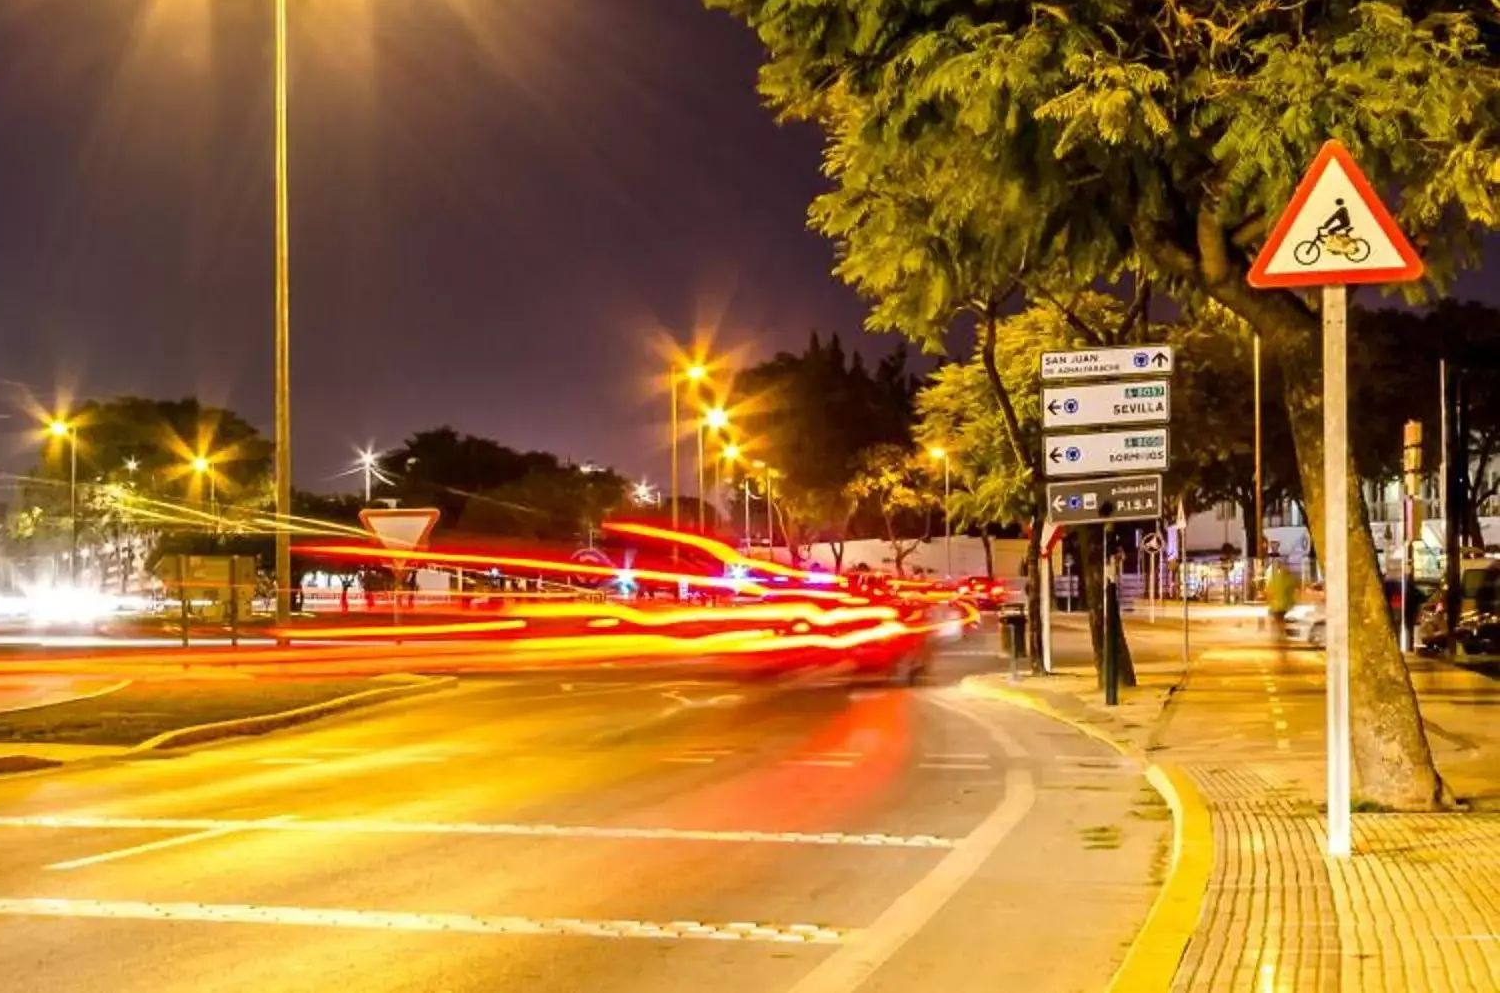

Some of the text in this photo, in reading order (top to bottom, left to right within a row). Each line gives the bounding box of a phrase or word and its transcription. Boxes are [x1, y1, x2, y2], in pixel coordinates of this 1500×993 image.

[1045, 354, 1099, 366] SAN JUAN
[1113, 402, 1165, 415] SEVILLA
[1109, 451, 1165, 463] BORMJOS
